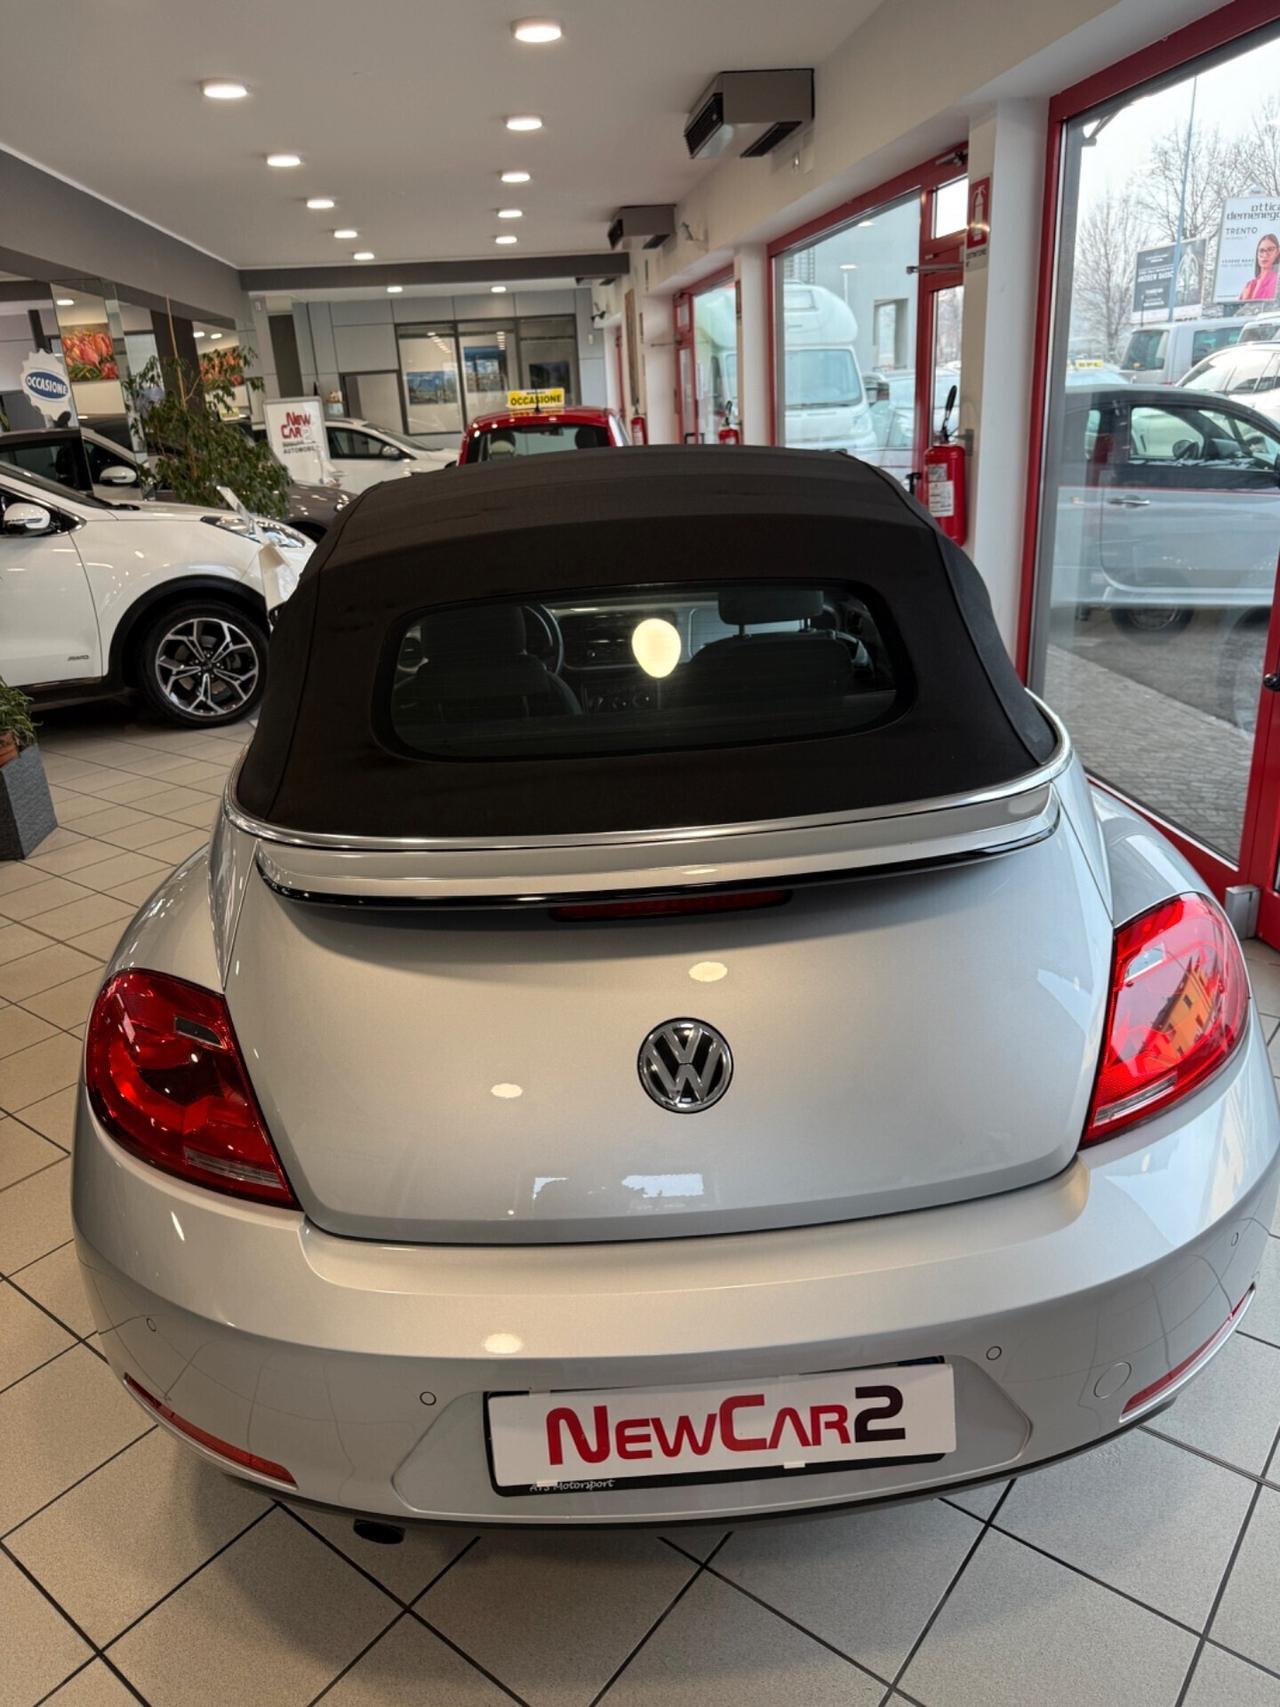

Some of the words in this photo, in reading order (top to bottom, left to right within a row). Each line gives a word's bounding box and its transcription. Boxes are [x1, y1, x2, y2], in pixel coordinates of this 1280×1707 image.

[1225, 227, 1258, 236] TRENTO
[26, 376, 68, 394] OCCASIONE
[510, 395, 561, 406] OCCASIONE
[285, 411, 311, 426] NEW
